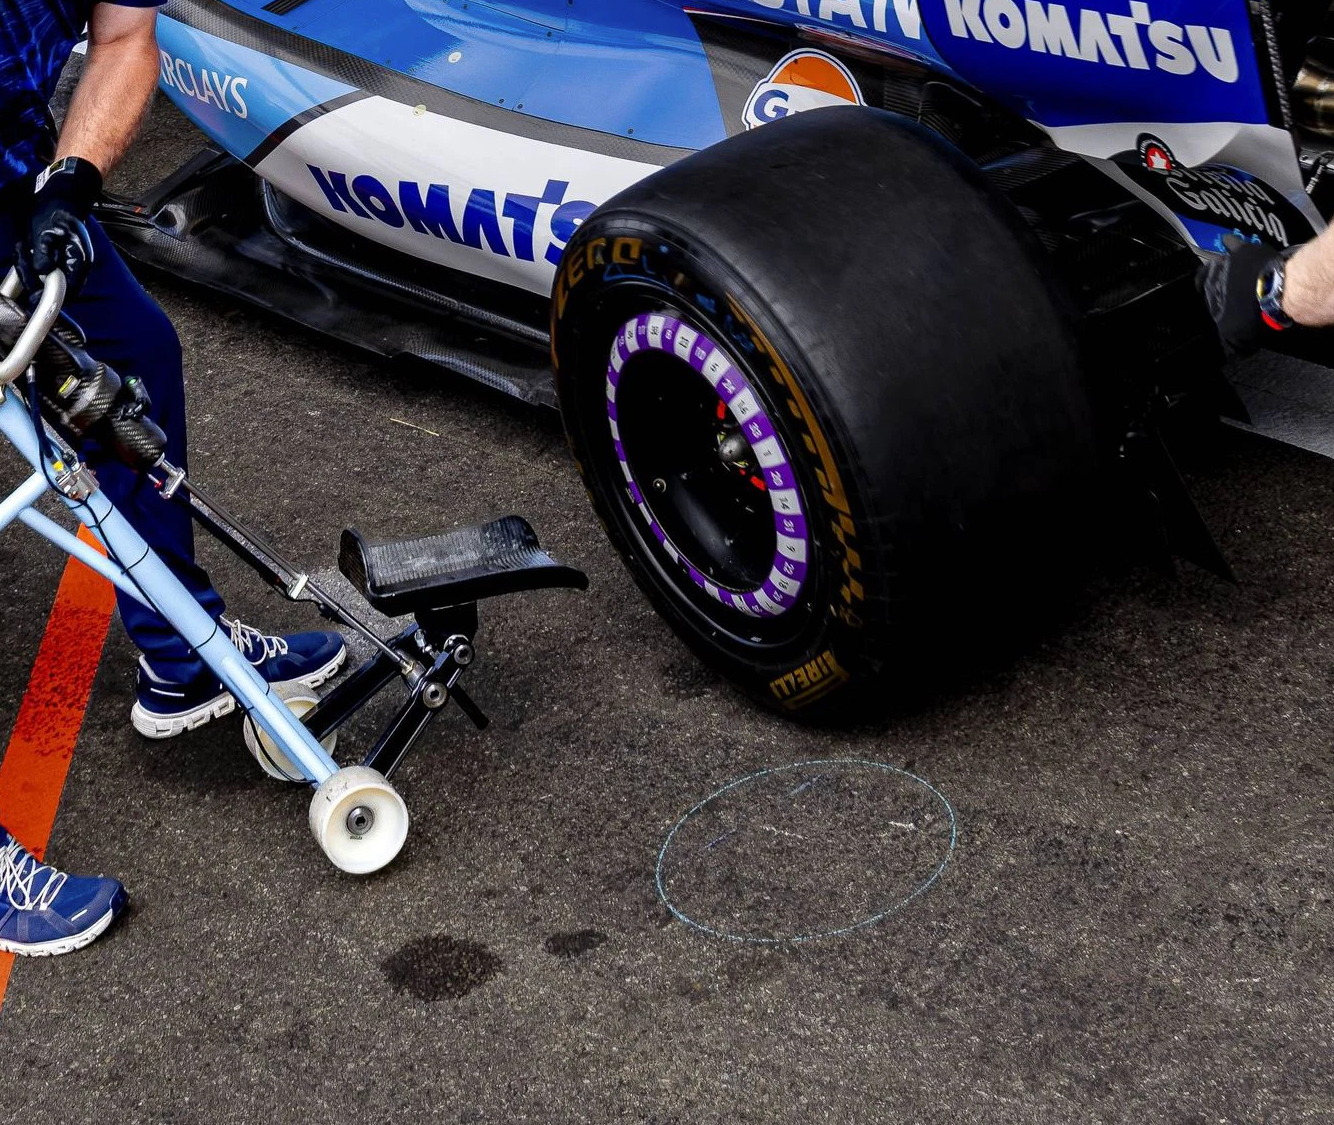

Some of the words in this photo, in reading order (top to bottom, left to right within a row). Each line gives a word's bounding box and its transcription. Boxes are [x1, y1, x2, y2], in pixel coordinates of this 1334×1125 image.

[163, 49, 248, 120] RCLAYS
[1167, 177, 1289, 247] Galicia
[779, 498, 790, 510] 14
[770, 650, 838, 700] PIRELLI
